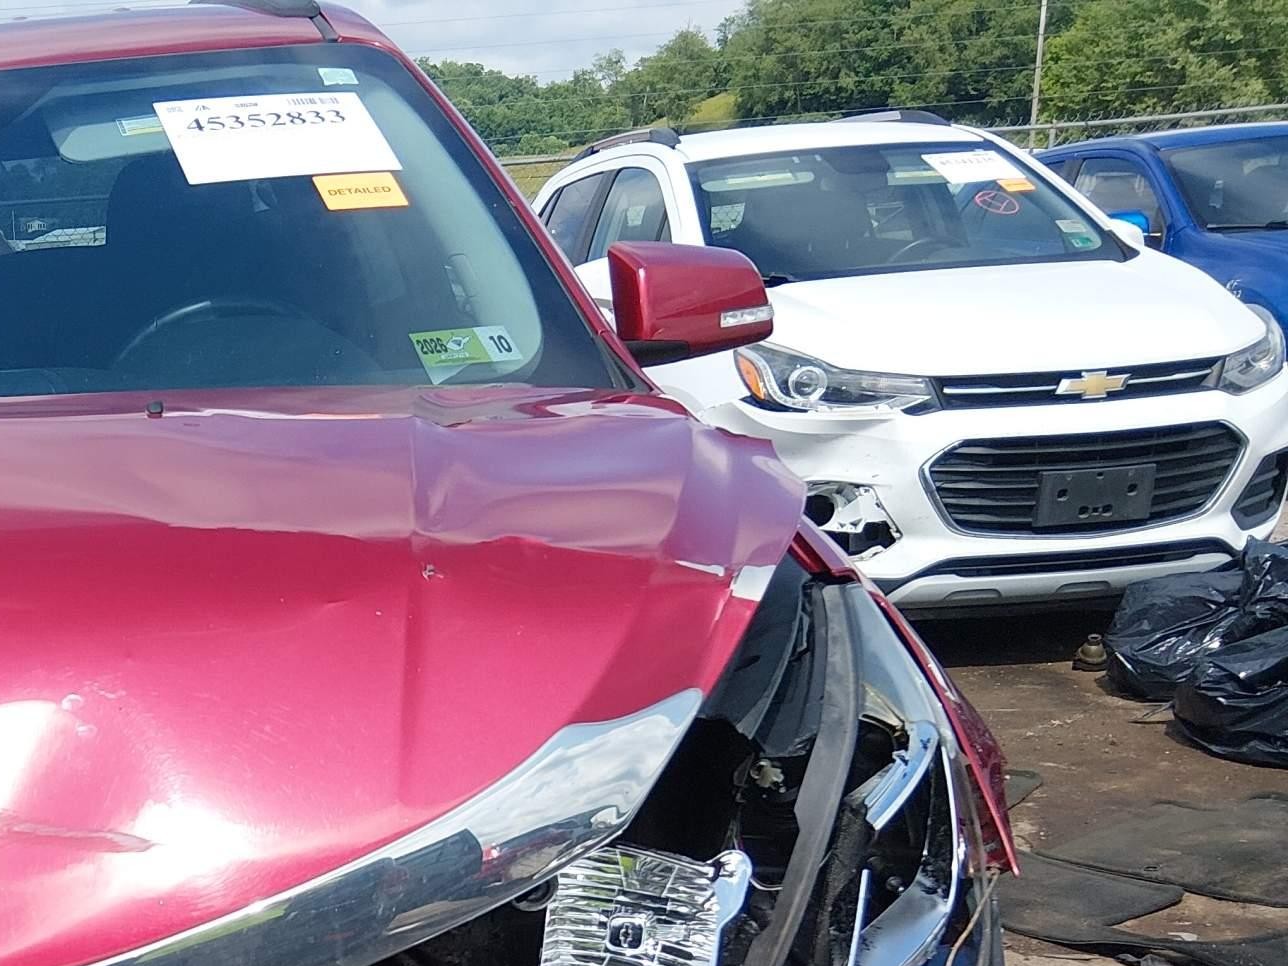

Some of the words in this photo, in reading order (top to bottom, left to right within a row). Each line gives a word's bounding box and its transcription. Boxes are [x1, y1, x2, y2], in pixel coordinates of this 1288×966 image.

[186, 109, 346, 132] 45352833
[327, 185, 392, 197] DETAILED
[415, 337, 448, 355] 2026
[489, 334, 513, 354] 10
